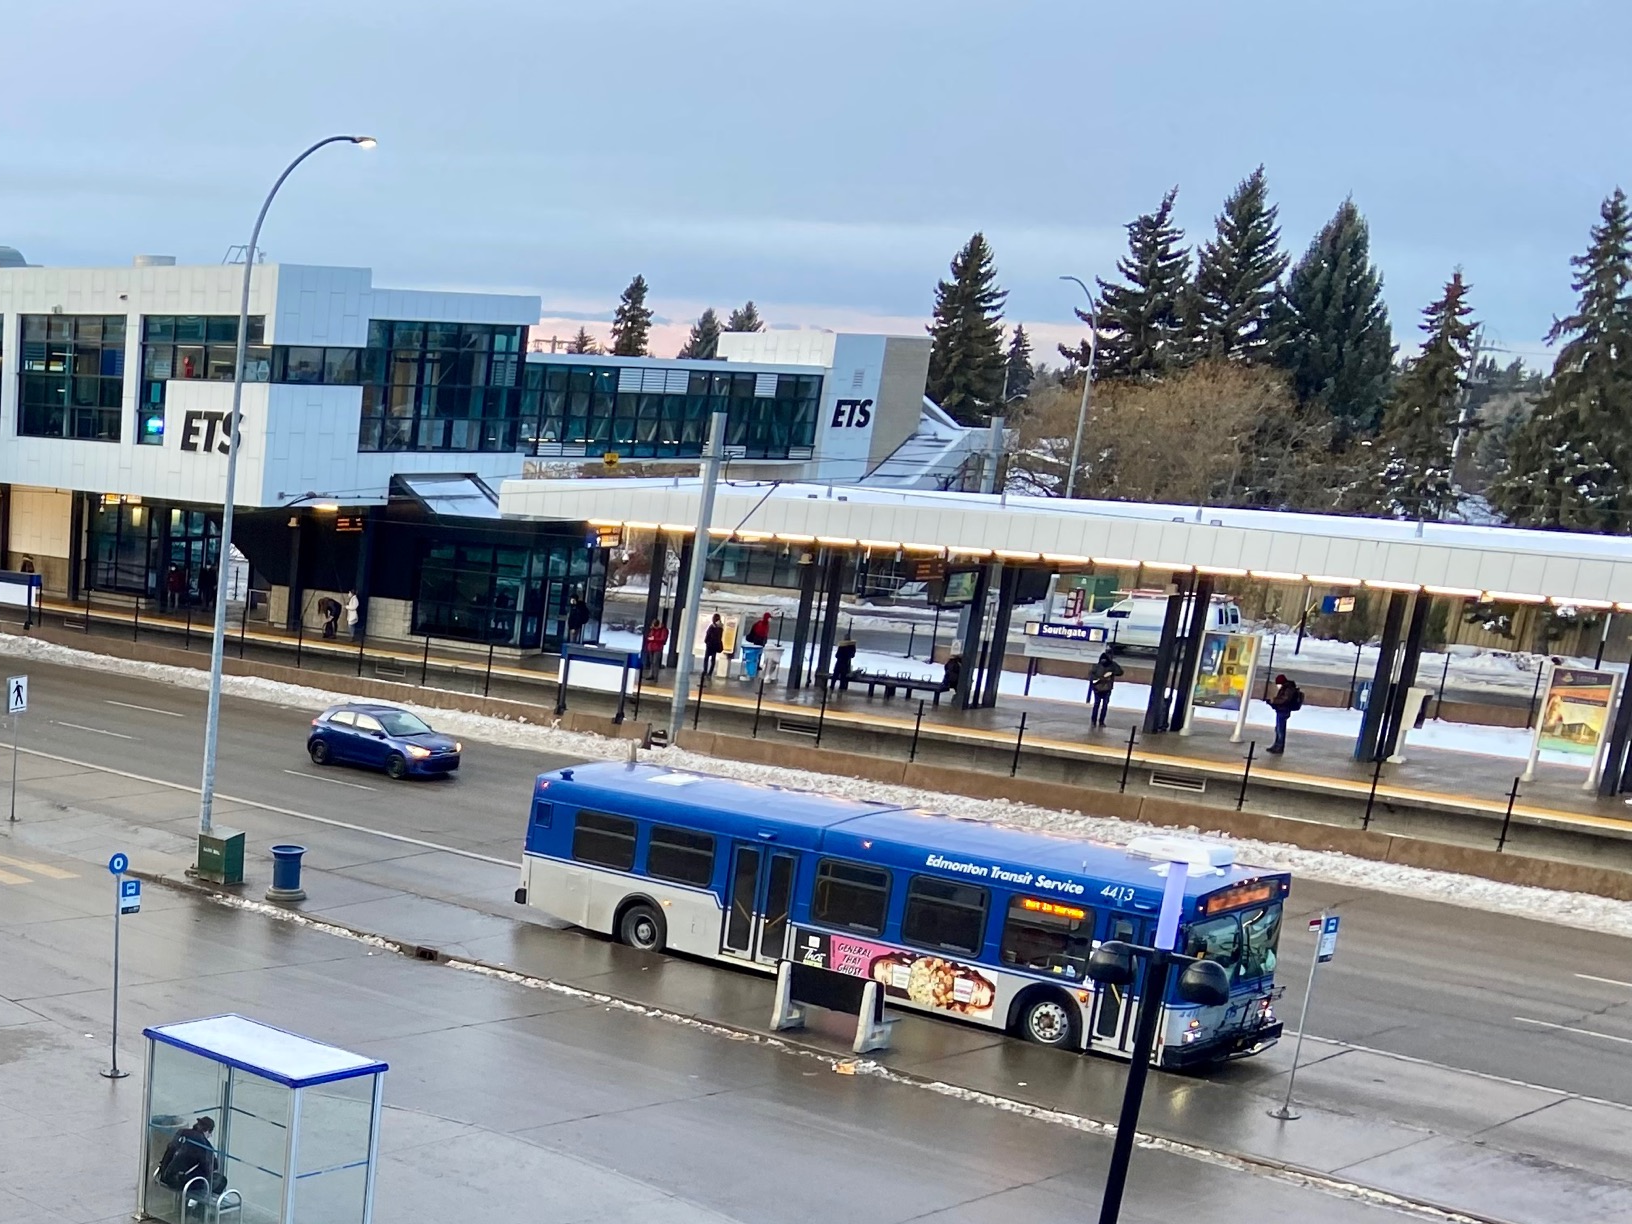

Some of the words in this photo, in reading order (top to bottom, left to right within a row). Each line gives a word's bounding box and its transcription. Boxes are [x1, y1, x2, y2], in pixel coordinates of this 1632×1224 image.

[831, 399, 873, 428] ETS
[180, 410, 244, 455] ETS
[1043, 625, 1086, 638] Southgate
[926, 854, 988, 877] Edmonton
[990, 866, 1033, 885] Transit
[1035, 875, 1085, 895] Service
[1100, 885, 1135, 901] 4413
[838, 943, 871, 958] GENERAL
